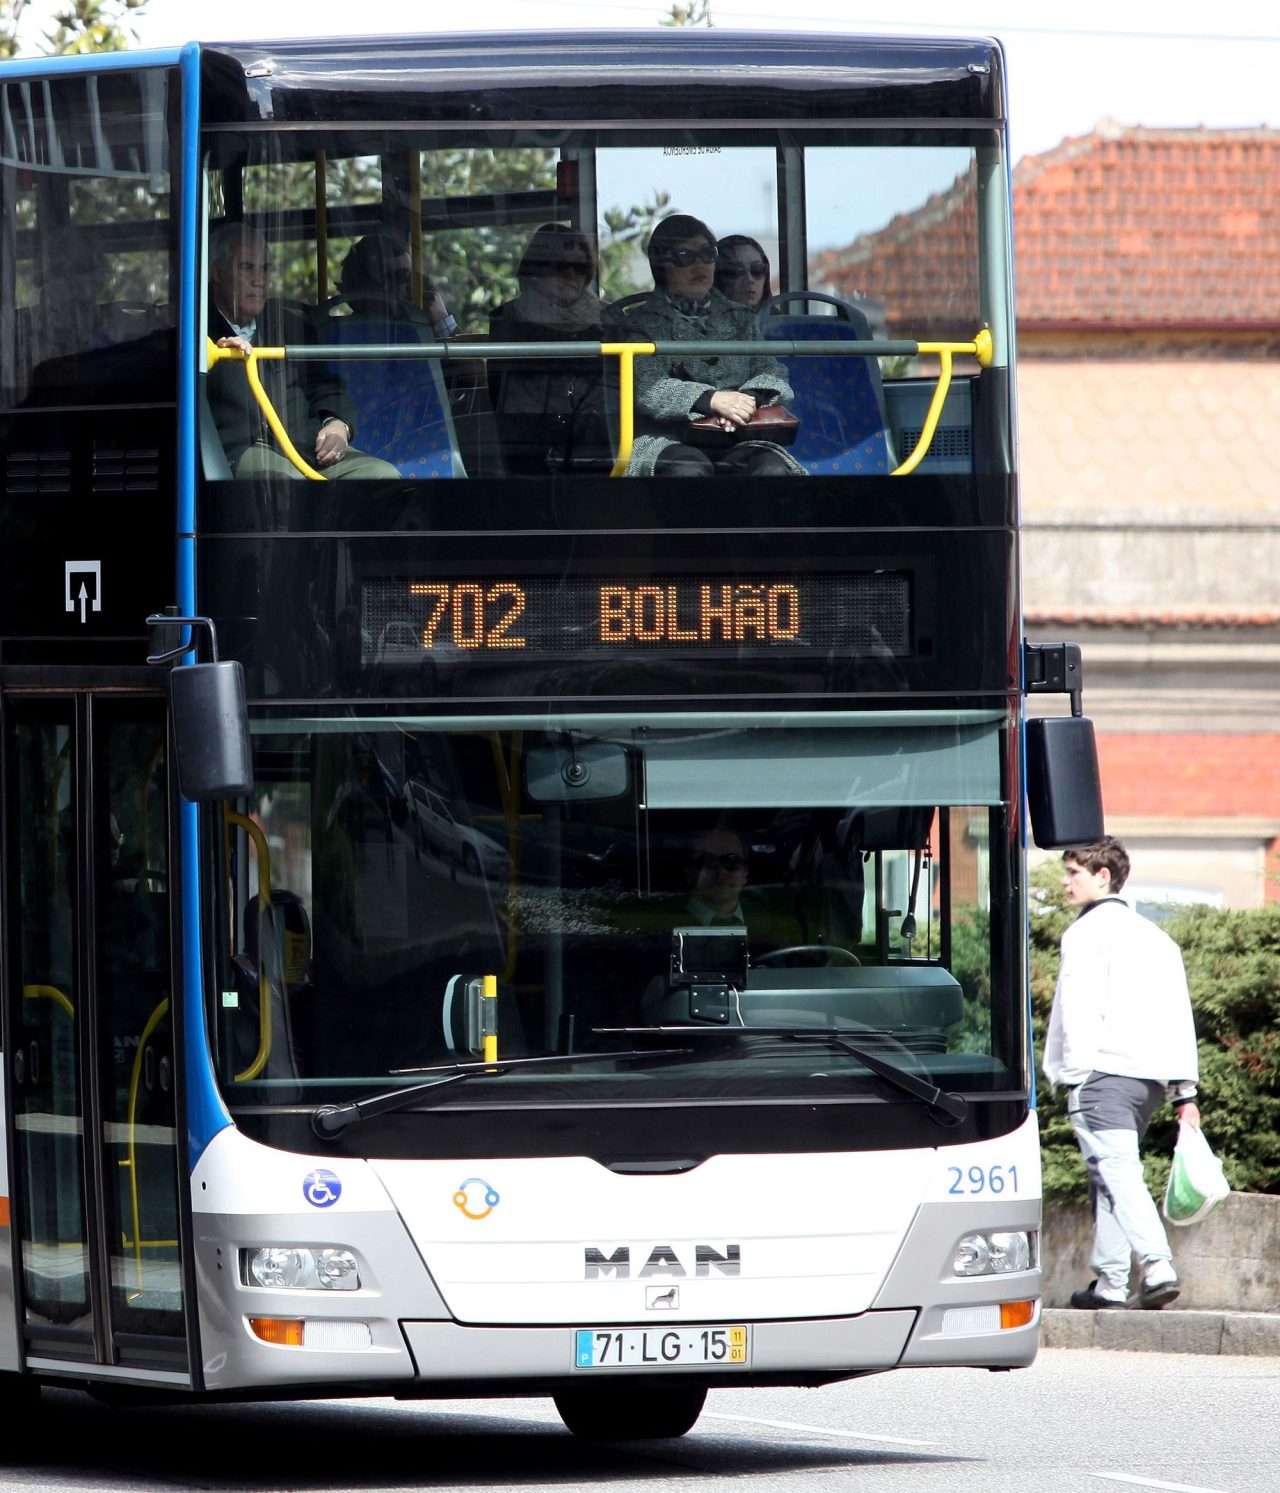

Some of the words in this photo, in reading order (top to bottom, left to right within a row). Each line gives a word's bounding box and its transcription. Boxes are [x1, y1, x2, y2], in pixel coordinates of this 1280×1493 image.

[410, 583, 526, 648] 702
[600, 584, 800, 641] BOLHÃO
[947, 1165, 1018, 1194] 2961
[584, 1244, 741, 1280] MAN
[733, 1331, 742, 1341] 11
[581, 1353, 589, 1364] P
[731, 1349, 741, 1359] 01
